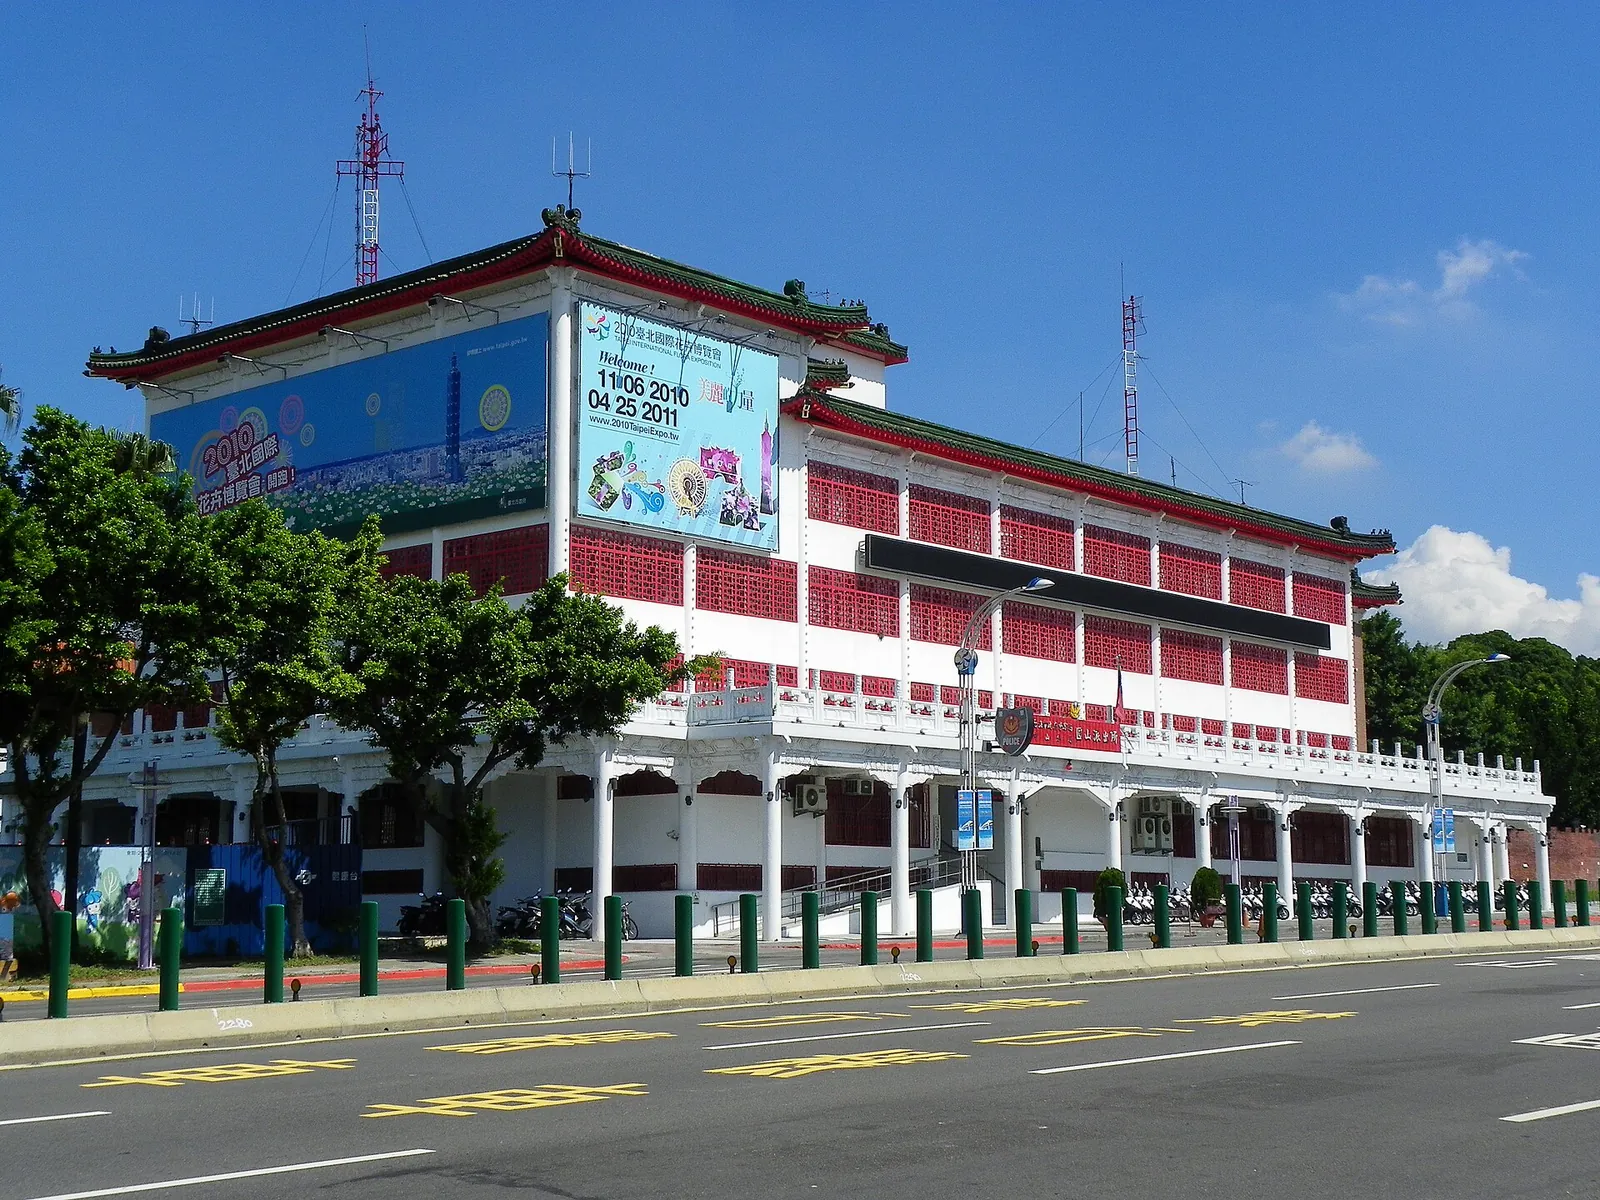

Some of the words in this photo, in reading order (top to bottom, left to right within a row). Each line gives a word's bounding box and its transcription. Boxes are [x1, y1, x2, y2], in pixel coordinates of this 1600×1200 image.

[599, 350, 648, 374] Welcome
[650, 364, 655, 375] !
[588, 389, 677, 427] 04/25/2011
[589, 415, 679, 441] www.2010TaipeiExpo.tw
[204, 424, 253, 476] 2010
[226, 434, 278, 483] 臺北國際
[198, 475, 261, 514] 花卉博覽會
[1002, 737, 1020, 746] POLICE
[218, 1018, 252, 1030] 2280
